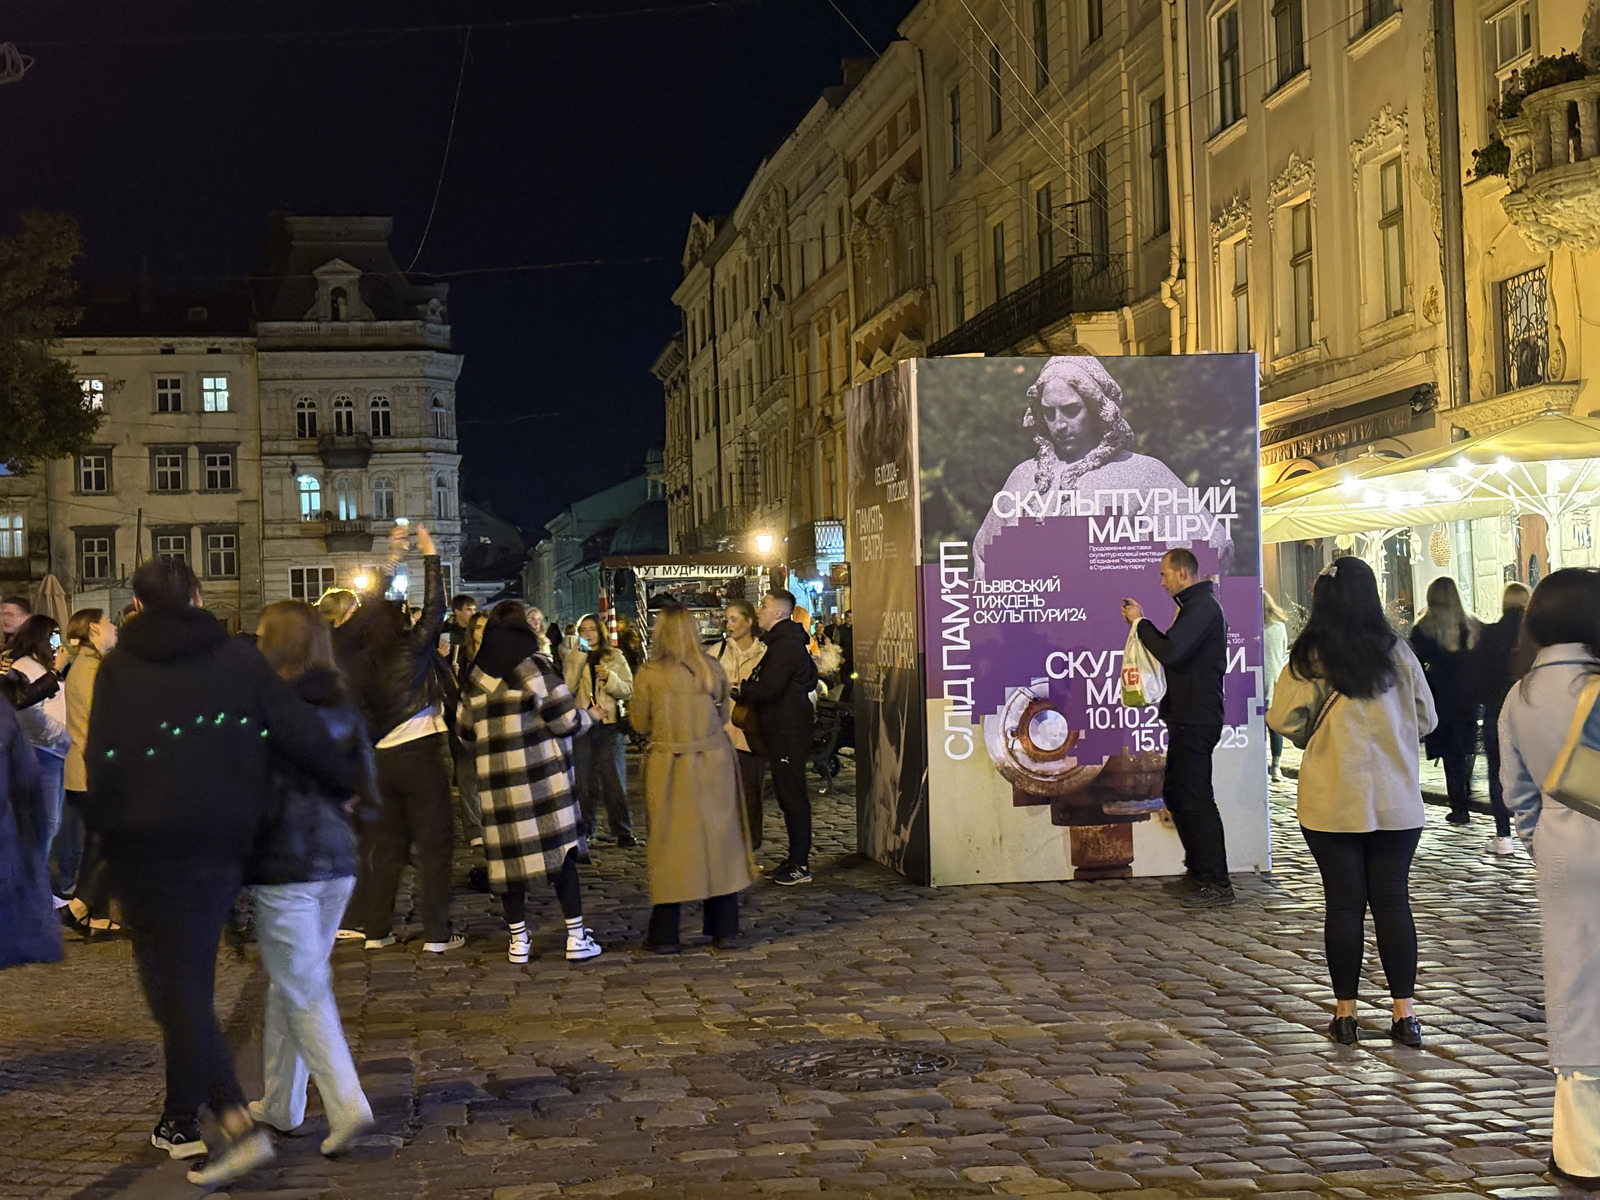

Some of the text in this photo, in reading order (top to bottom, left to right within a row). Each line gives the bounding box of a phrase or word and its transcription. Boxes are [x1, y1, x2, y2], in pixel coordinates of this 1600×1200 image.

[992, 479, 1236, 518] СКУЛЬПТУРНИЙ
[1088, 513, 1239, 544] МАРШРУТ
[859, 533, 884, 562] ТЕАТРУ
[637, 564, 745, 577] ТУТ МУДРІ КНИГИ
[973, 576, 1061, 594] ЛЬВІВСЬКИЙ
[973, 594, 1045, 609] ТИЖДЕНЬ
[973, 608, 1087, 624] СКУЛЬПТУРИ'24
[942, 677, 975, 760] СЛІД
